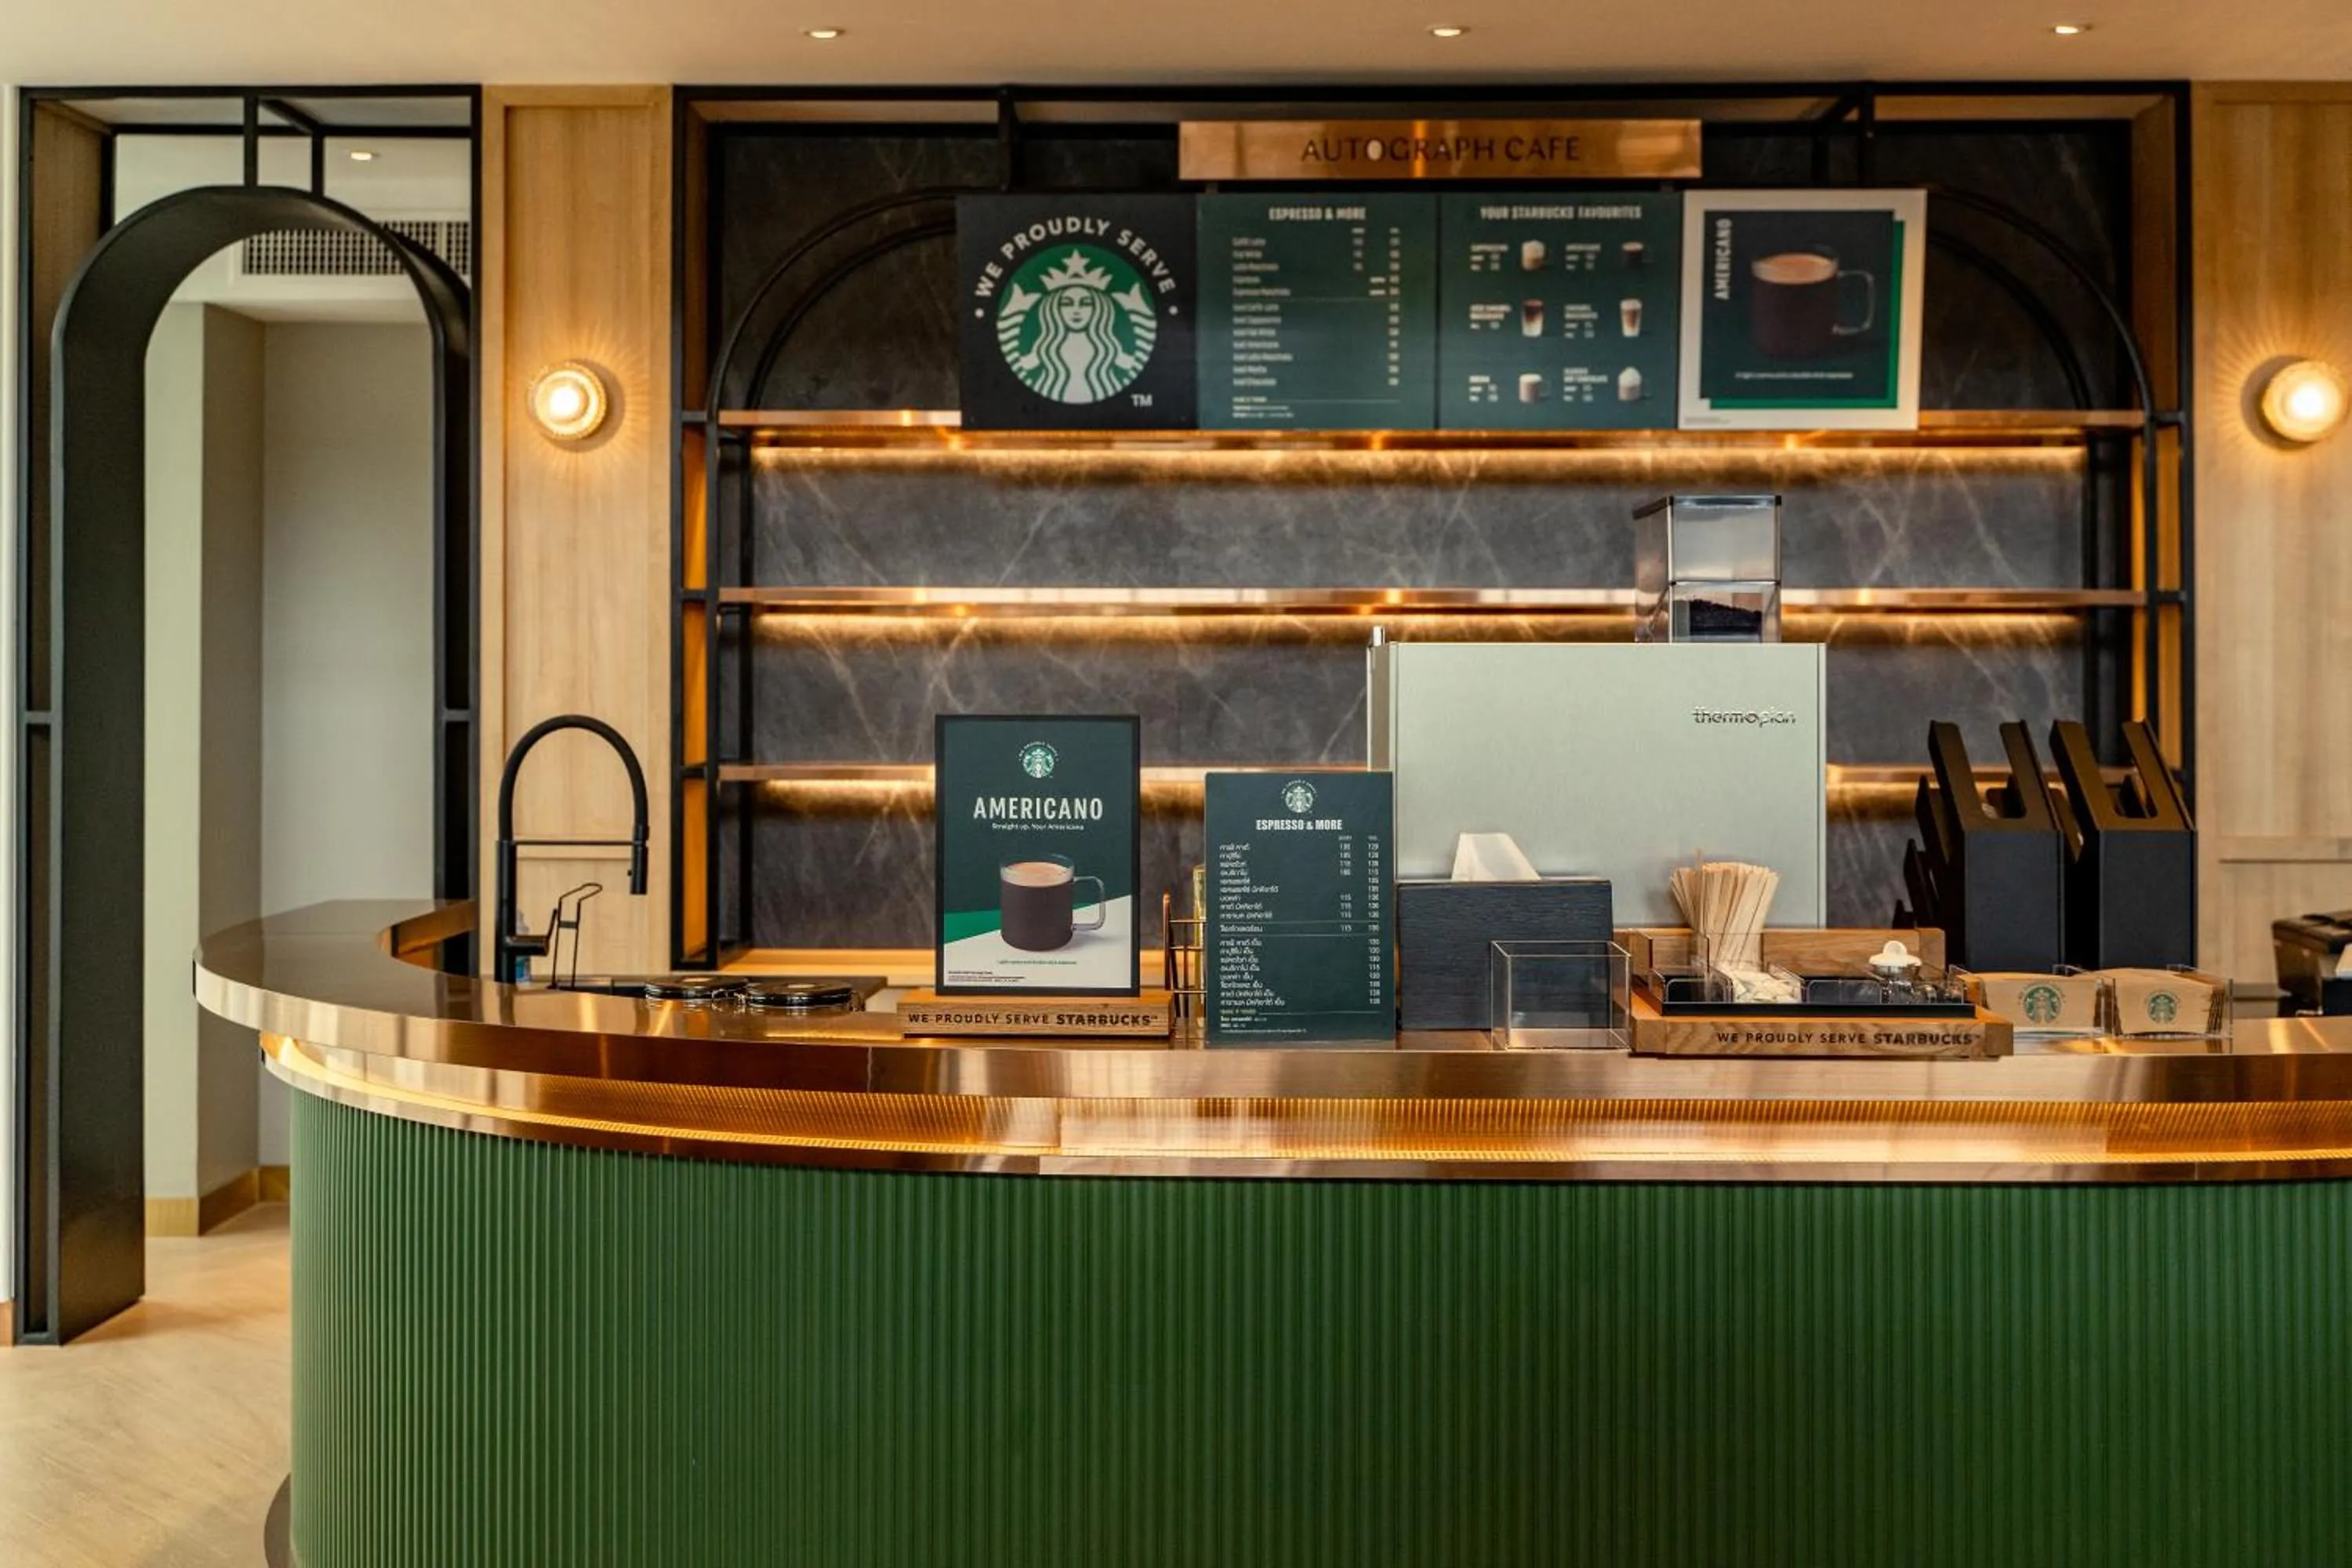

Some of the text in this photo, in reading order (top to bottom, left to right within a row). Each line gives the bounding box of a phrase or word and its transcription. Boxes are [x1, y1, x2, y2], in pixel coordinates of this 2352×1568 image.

[1301, 136, 1581, 162] AUTOGRAPH CAFE
[1268, 207, 1323, 220] ESPRESSO
[1336, 207, 1367, 220] MORE
[1480, 206, 1509, 219] YOUR
[1512, 206, 1574, 220] STARBUCKS
[975, 216, 1176, 297] WE PROUDLY SERVE
[1714, 218, 1733, 300] AMERICANO
[973, 797, 1103, 820] AMERICANO
[1255, 819, 1343, 830] ESPRESSO & MORE
[909, 1014, 928, 1023] WE
[935, 1014, 999, 1024] PROUDLY
[1006, 1014, 1050, 1024] SERVE
[1056, 1014, 1152, 1025] STARBUCKS
[1717, 1033, 1738, 1043] WE
[1746, 1033, 1813, 1044] PROUDLY
[1820, 1033, 1866, 1044] SERVE
[1873, 1033, 1974, 1045] STARBUCKS
